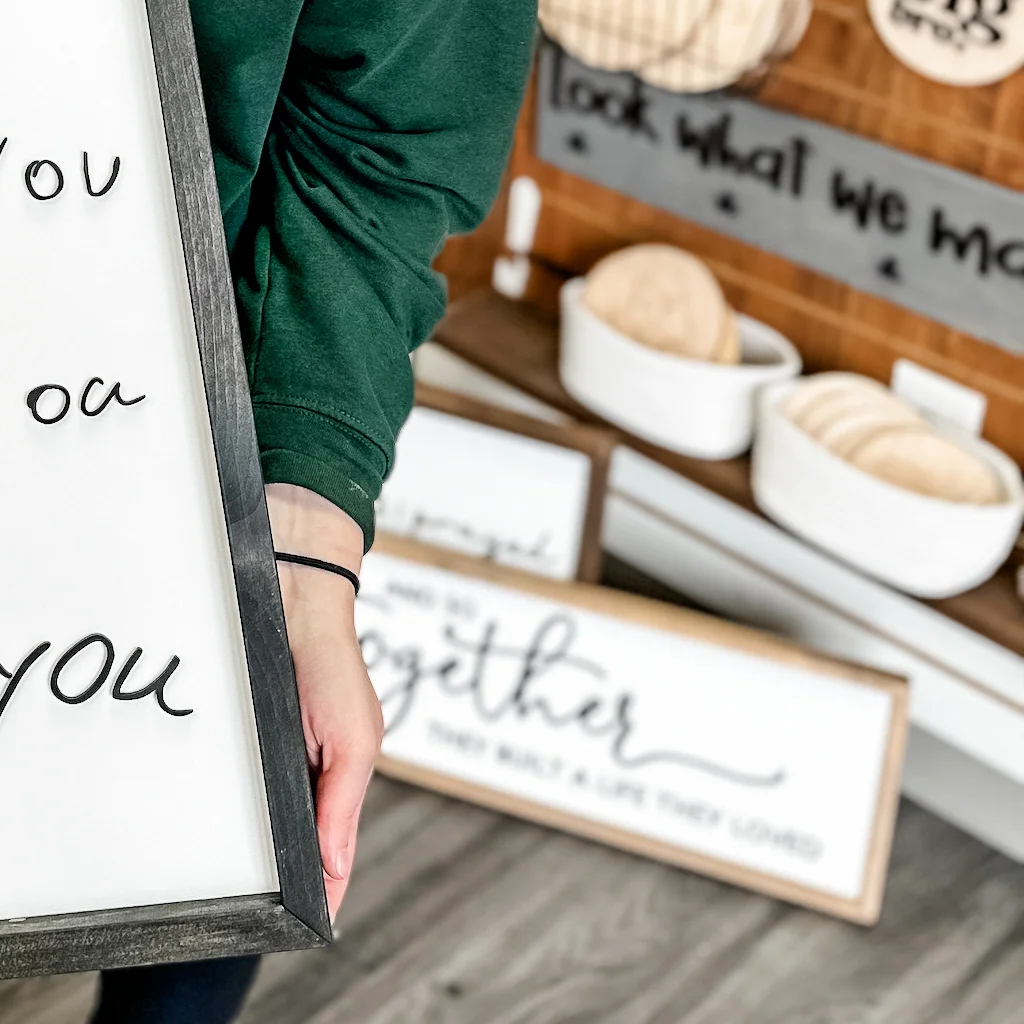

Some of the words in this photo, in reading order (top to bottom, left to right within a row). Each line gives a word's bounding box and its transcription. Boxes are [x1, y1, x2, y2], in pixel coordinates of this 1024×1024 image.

[549, 44, 658, 144] look
[675, 110, 812, 198] what
[830, 166, 908, 236] we
[356, 612, 787, 788] ogether
[657, 786, 723, 830] THEY
[729, 814, 826, 862] LOVED
